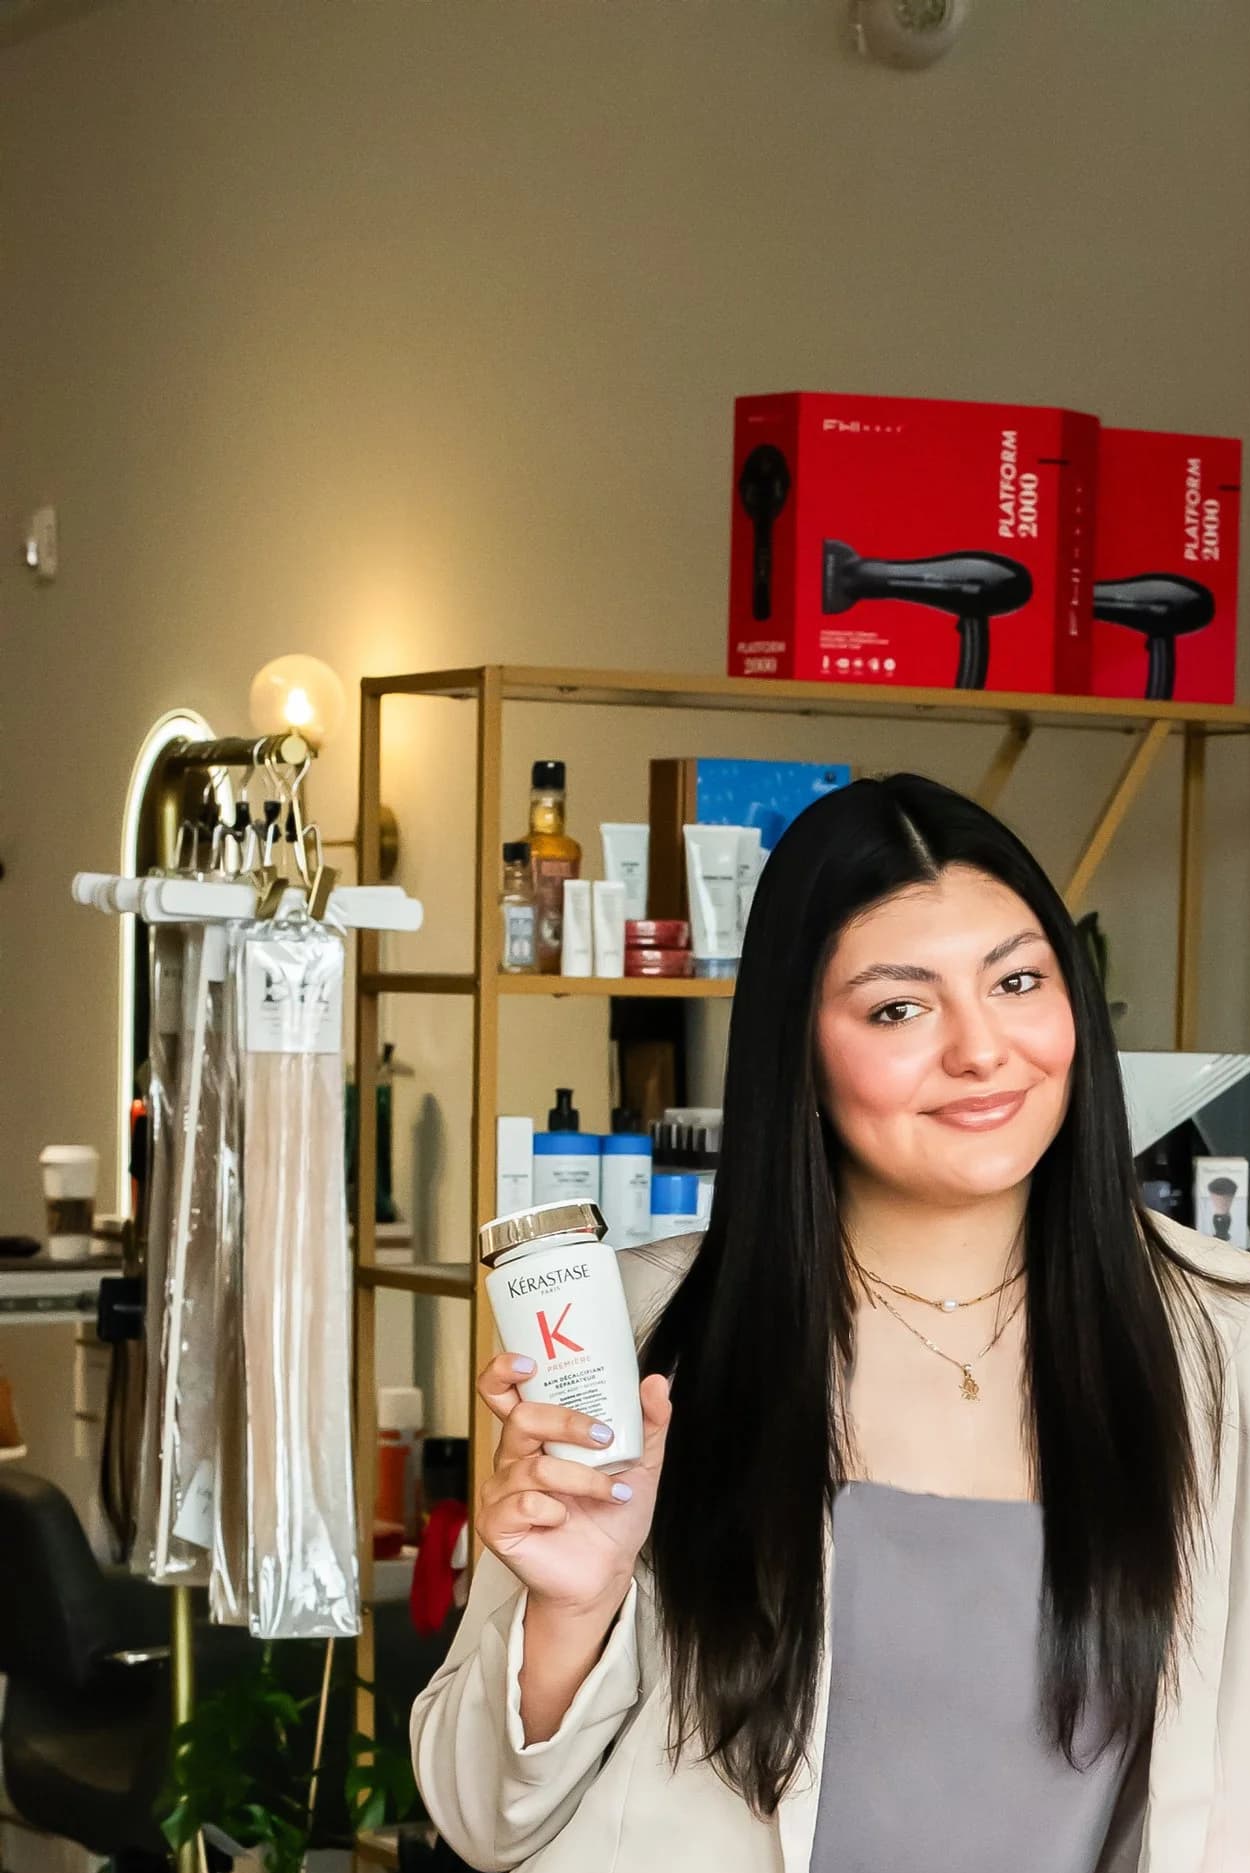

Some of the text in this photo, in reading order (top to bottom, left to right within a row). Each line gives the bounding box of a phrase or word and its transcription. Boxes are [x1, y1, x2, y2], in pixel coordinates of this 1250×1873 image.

[998, 430, 1017, 538] PLATFORM
[1018, 473, 1039, 538] 2000
[1184, 457, 1202, 561] PLATFORM
[1202, 499, 1221, 561] 2000
[507, 1263, 592, 1299] KÉRASTASE
[541, 1286, 561, 1296] PARIS
[536, 1302, 585, 1361] K
[547, 1355, 592, 1373] PREMIÈRE
